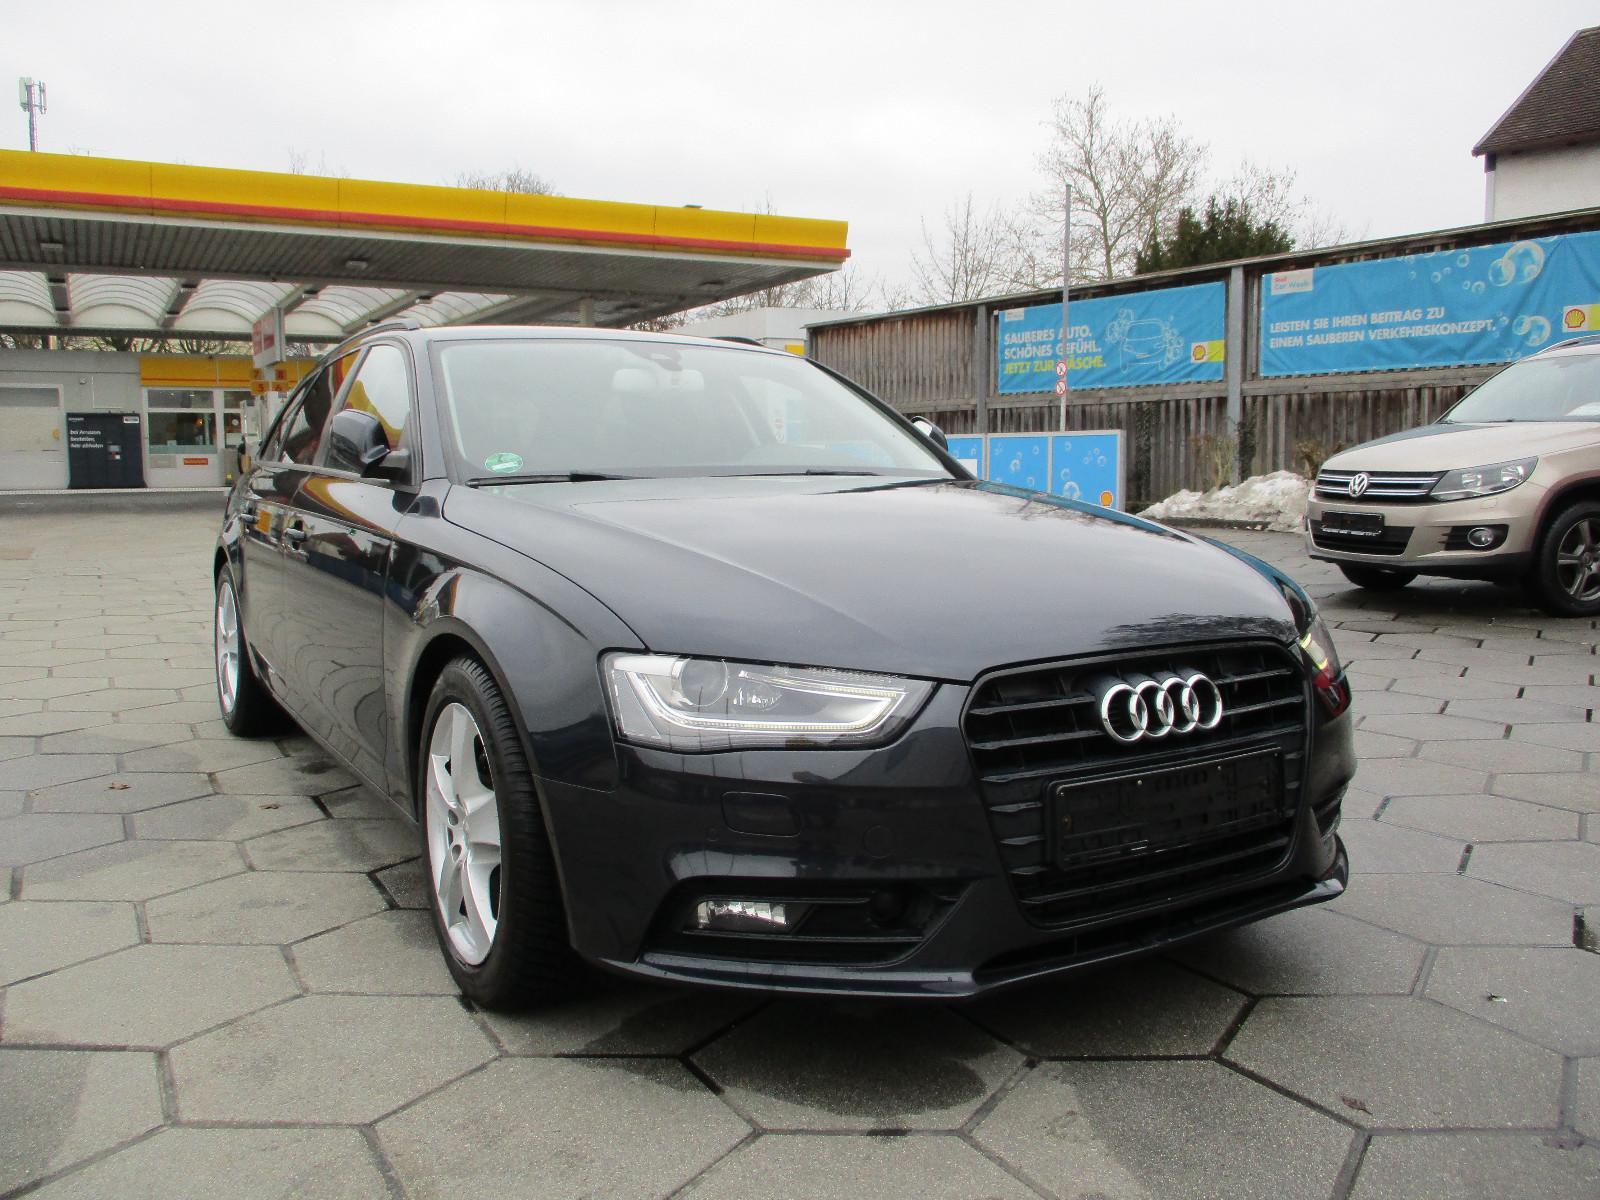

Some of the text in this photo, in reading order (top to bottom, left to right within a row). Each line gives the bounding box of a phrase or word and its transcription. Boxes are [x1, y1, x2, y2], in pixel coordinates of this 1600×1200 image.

[1270, 307, 1445, 333] LEISTEN SIE IHREN BEITRAG ZU
[1004, 329, 1055, 345] SAUBERES
[1270, 320, 1497, 349] EINEM SAUBEREN VERKEHRSKONZEPT.
[1004, 343, 1053, 360] SCHÖNES
[1005, 355, 1107, 375] JETZT ZUR ÄSCHE.
